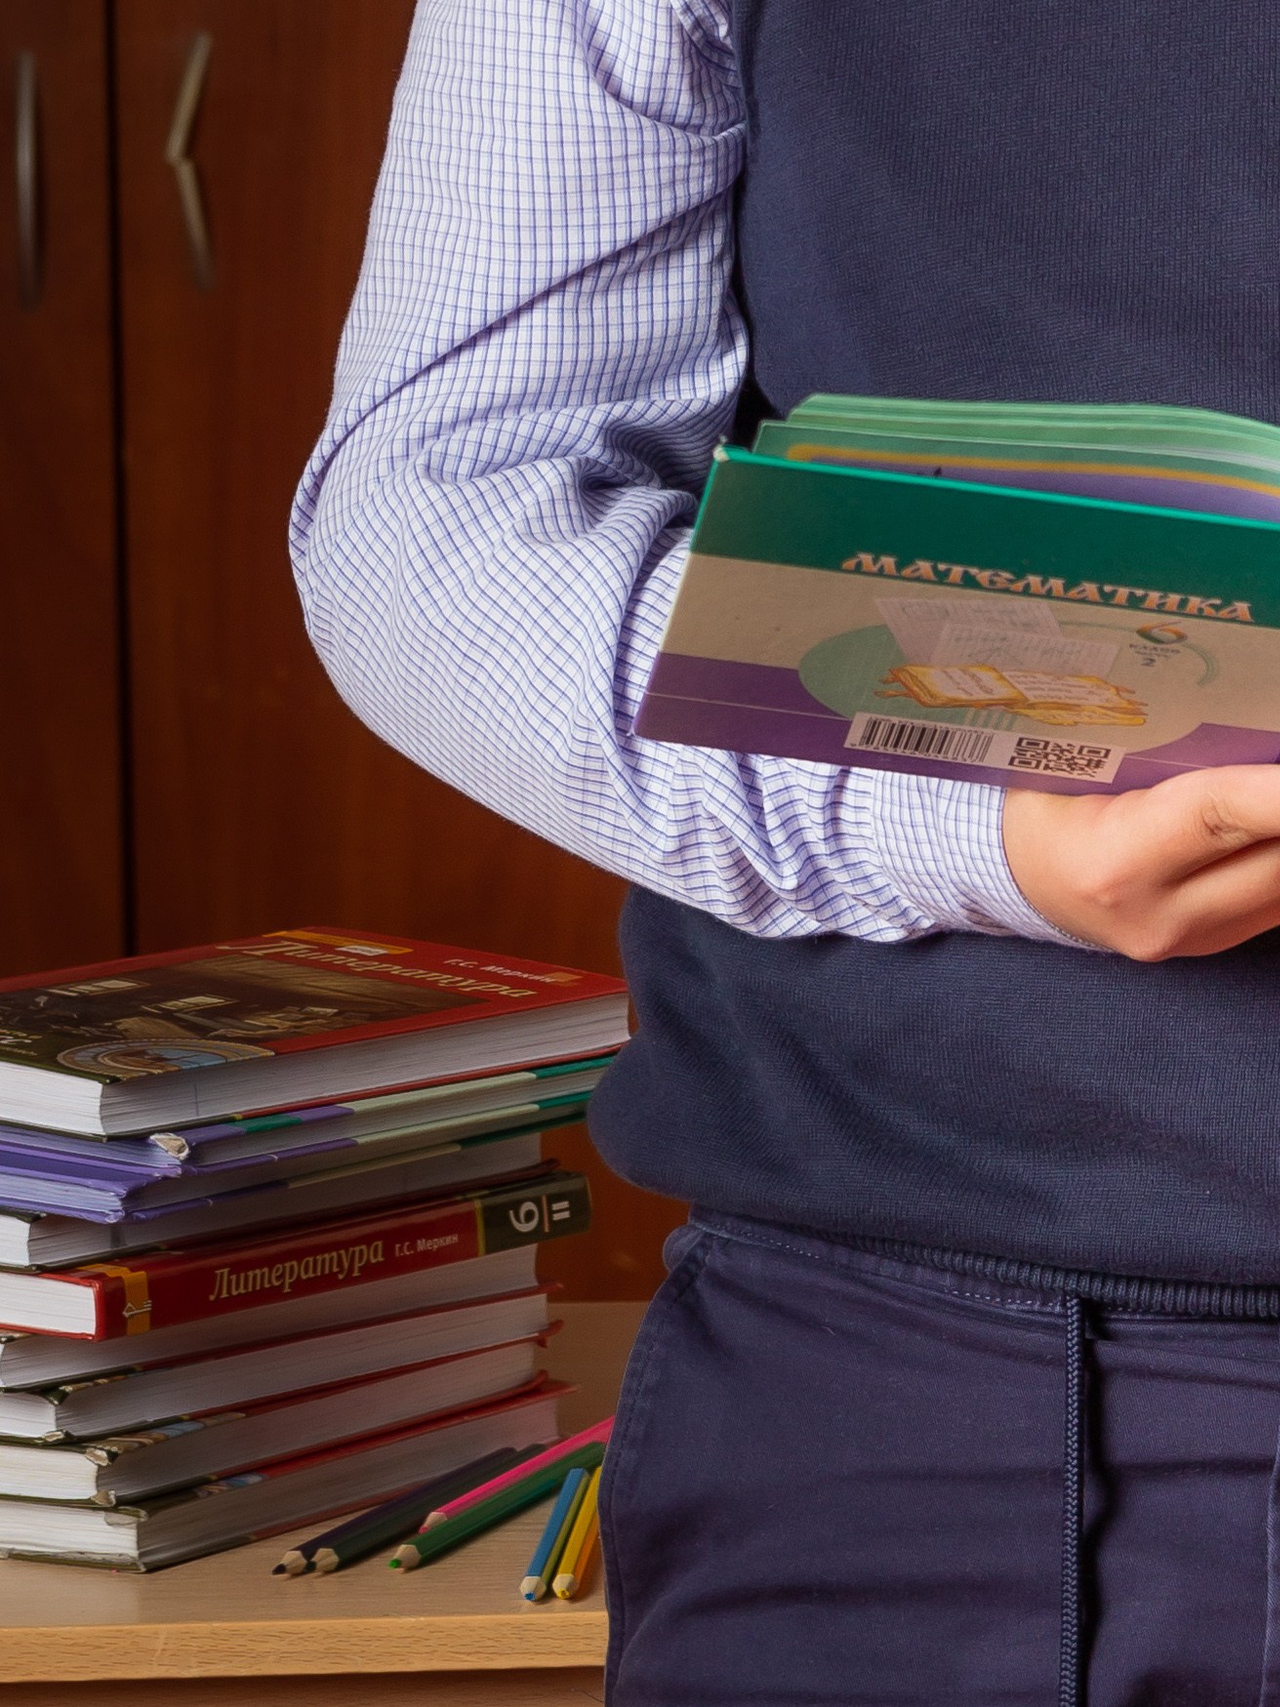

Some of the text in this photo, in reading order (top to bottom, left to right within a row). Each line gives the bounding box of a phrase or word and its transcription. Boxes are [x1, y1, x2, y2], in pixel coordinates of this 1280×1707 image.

[841, 550, 1255, 623] МАТЕМАТИКА
[1136, 619, 1188, 645] 6
[1140, 656, 1157, 668] 2
[214, 939, 538, 998] Литература
[444, 958, 557, 984] Г.С. Меркин
[209, 1233, 460, 1302] Литература Г.С. Меркин
